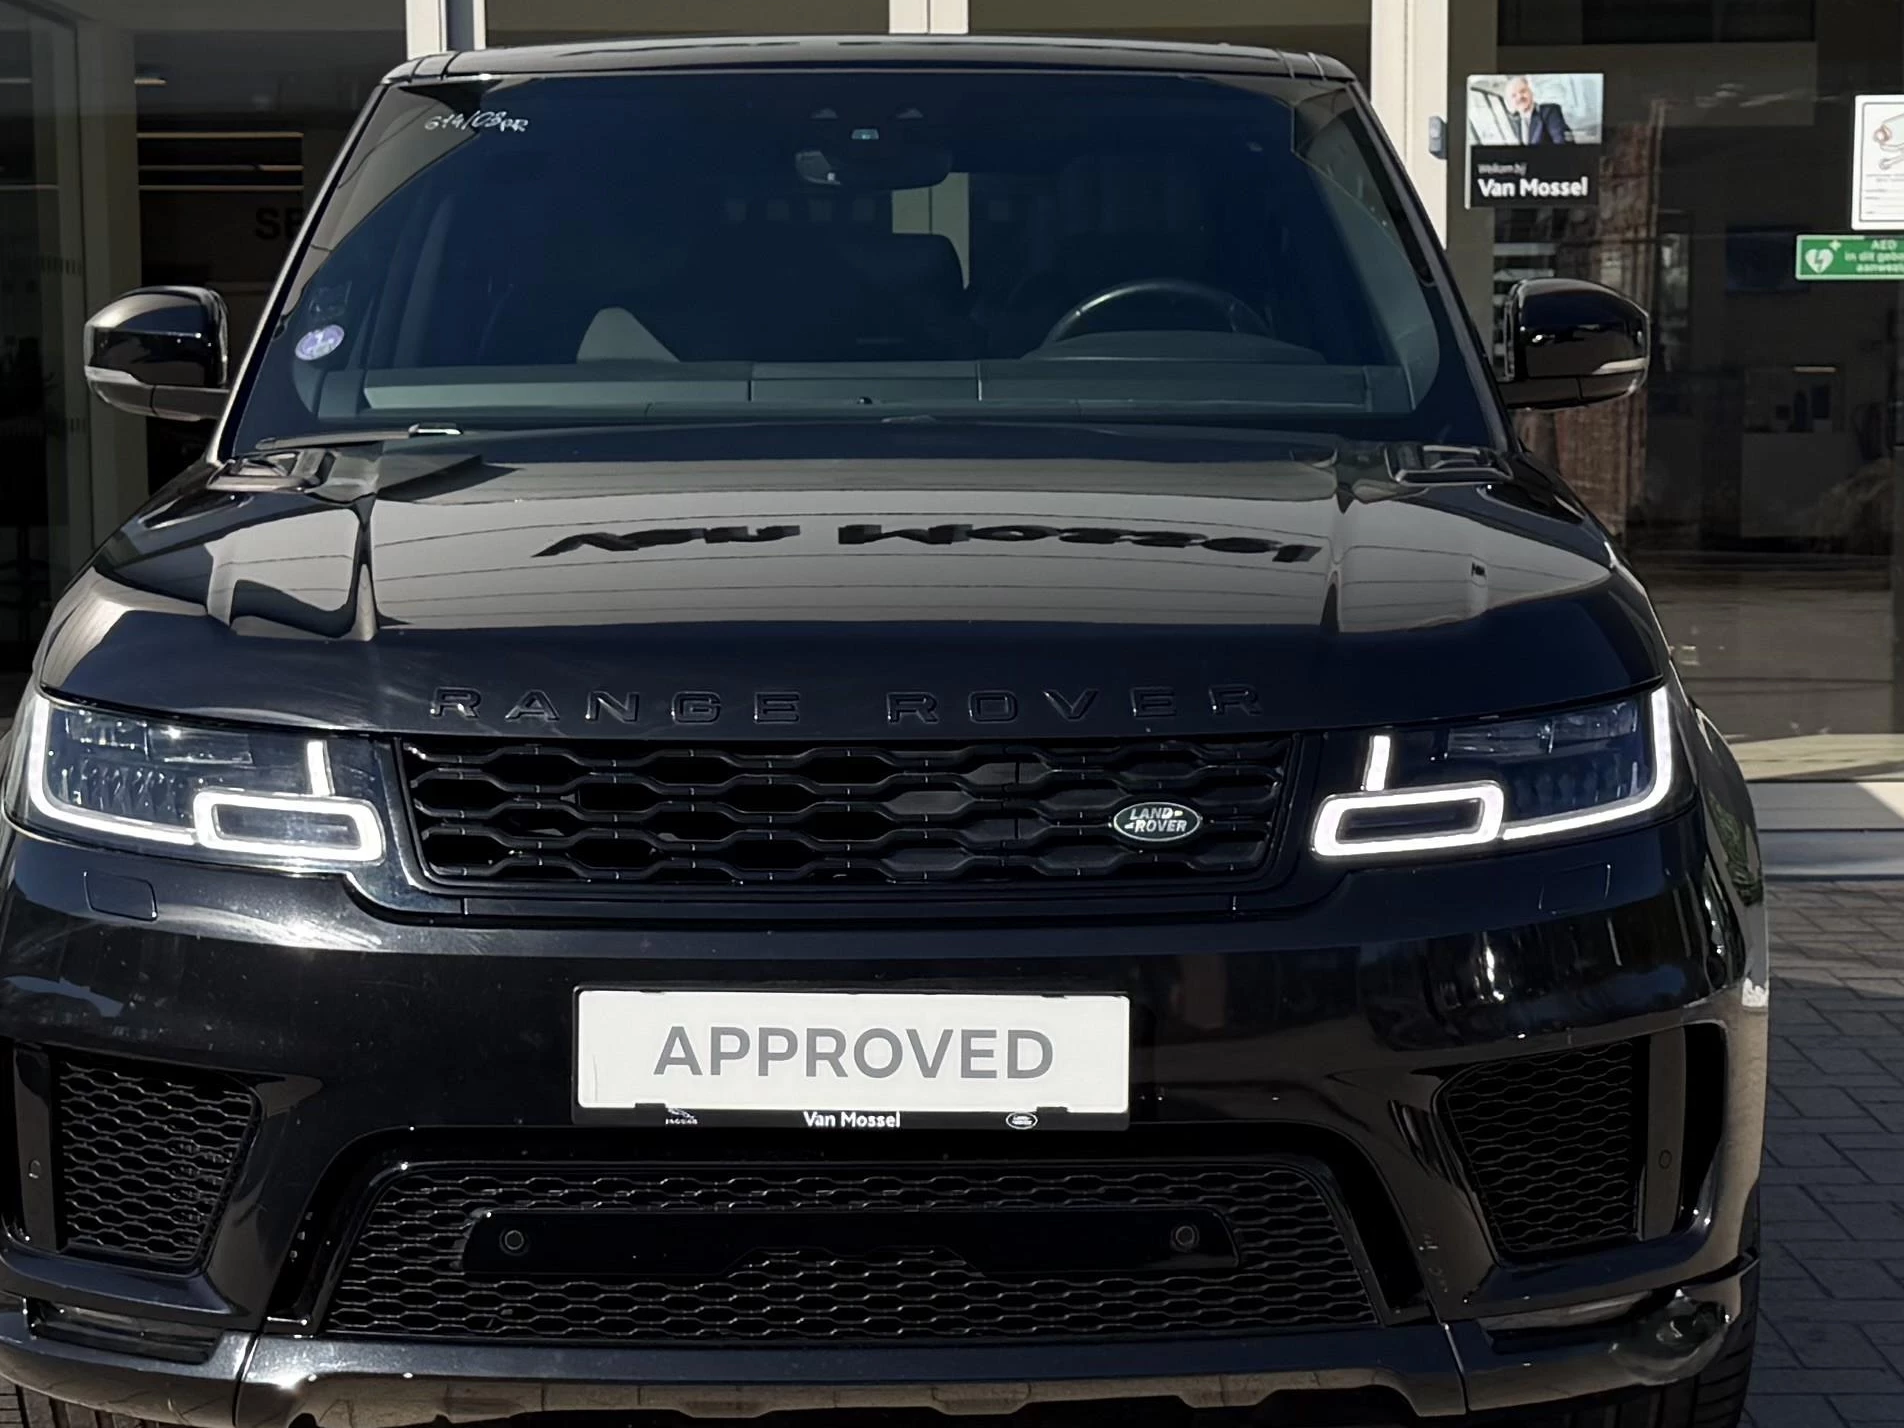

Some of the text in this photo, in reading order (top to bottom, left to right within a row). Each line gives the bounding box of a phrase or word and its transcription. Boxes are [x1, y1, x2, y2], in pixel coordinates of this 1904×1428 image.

[1477, 175, 1588, 197] Van Mossel
[1870, 239, 1898, 251] AED
[1844, 252, 1857, 261] in
[1859, 251, 1875, 262] dit
[430, 682, 1265, 725] RANGE ROVER
[1129, 807, 1174, 820] LAND
[1134, 819, 1188, 833] ROVER
[653, 1025, 1054, 1079] APPROVED
[803, 1110, 900, 1128] Van Mossel
